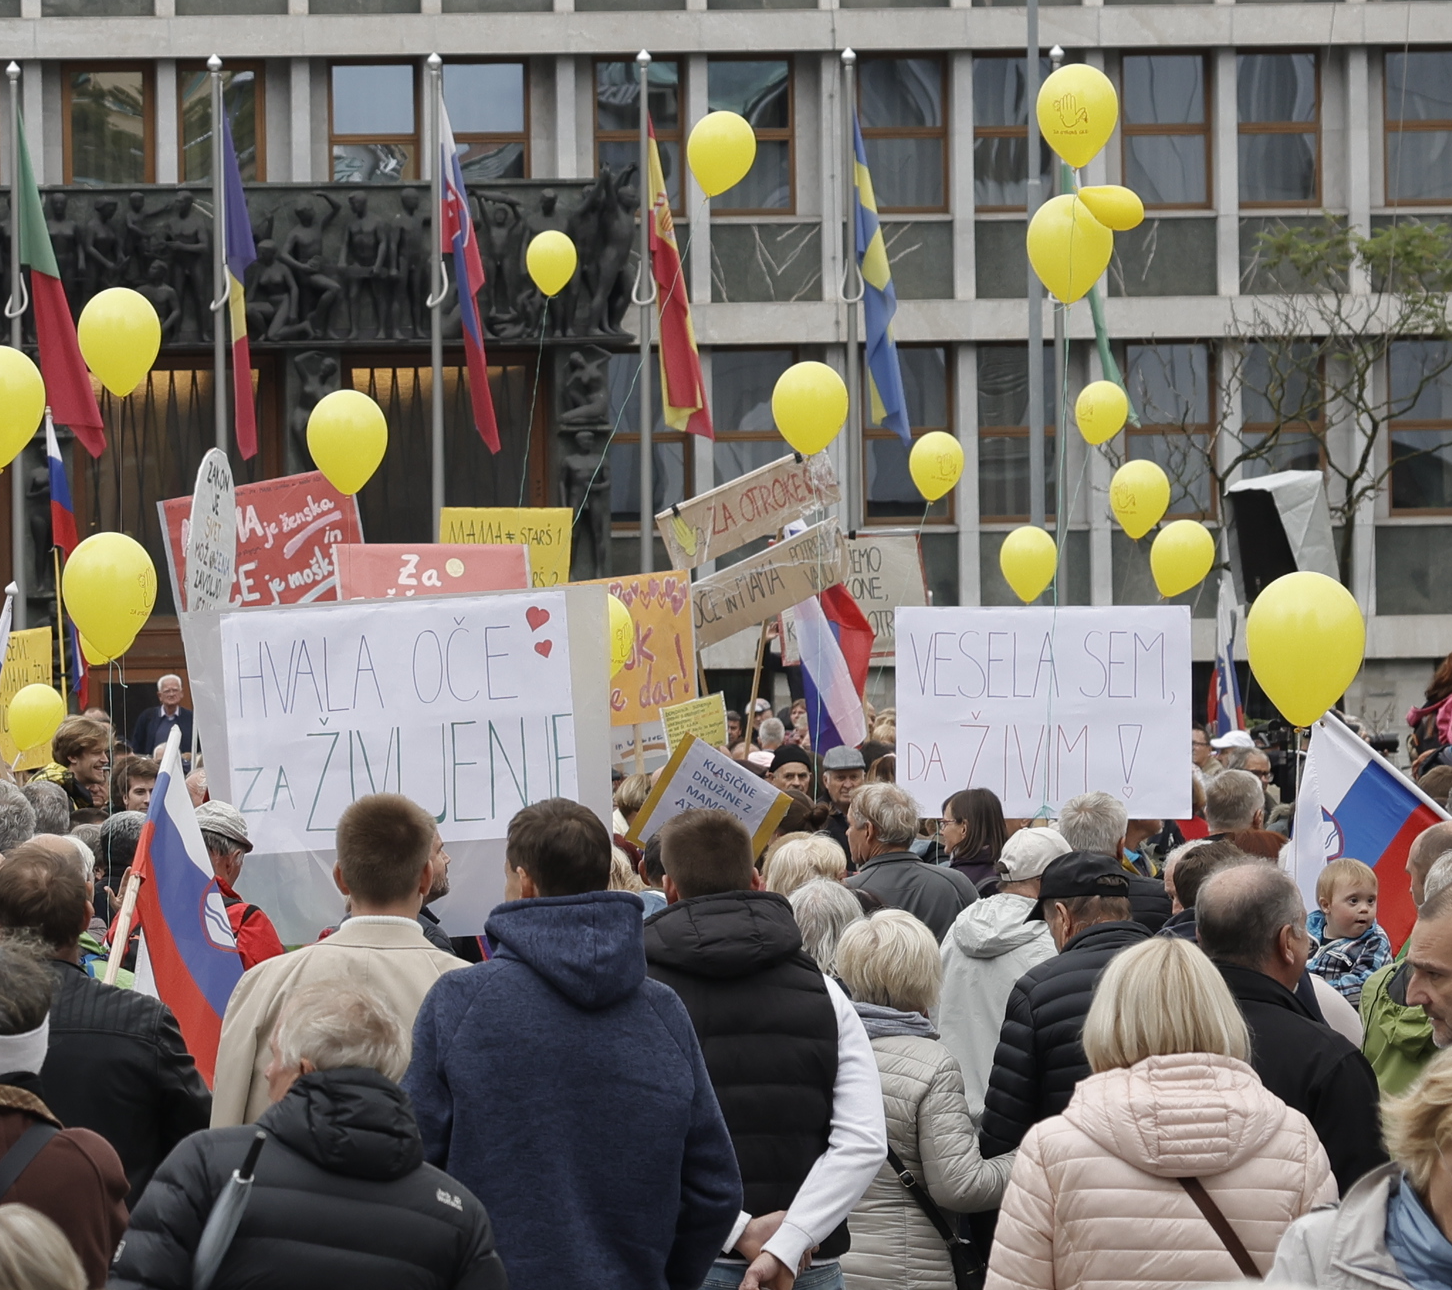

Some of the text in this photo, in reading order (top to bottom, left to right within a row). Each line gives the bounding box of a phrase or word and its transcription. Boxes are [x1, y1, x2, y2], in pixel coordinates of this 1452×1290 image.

[207, 461, 230, 493] ZAKON
[263, 522, 280, 549] je
[279, 495, 335, 534] ženska
[707, 503, 737, 535] ZA
[739, 472, 806, 522] OTROKE
[324, 526, 343, 544] in
[448, 520, 503, 545] MAMA
[520, 523, 553, 546] STARŠ
[265, 574, 286, 605] je
[236, 634, 385, 719] HVALA
[412, 615, 519, 706] OČE
[908, 630, 1177, 705] VESELA SEM,
[703, 758, 757, 799] KLASIČNE
[907, 741, 946, 783] DA
[959, 710, 1089, 801] ŽIVIM
[234, 766, 296, 814] ZA
[692, 770, 753, 814] DRUŽINE Z
